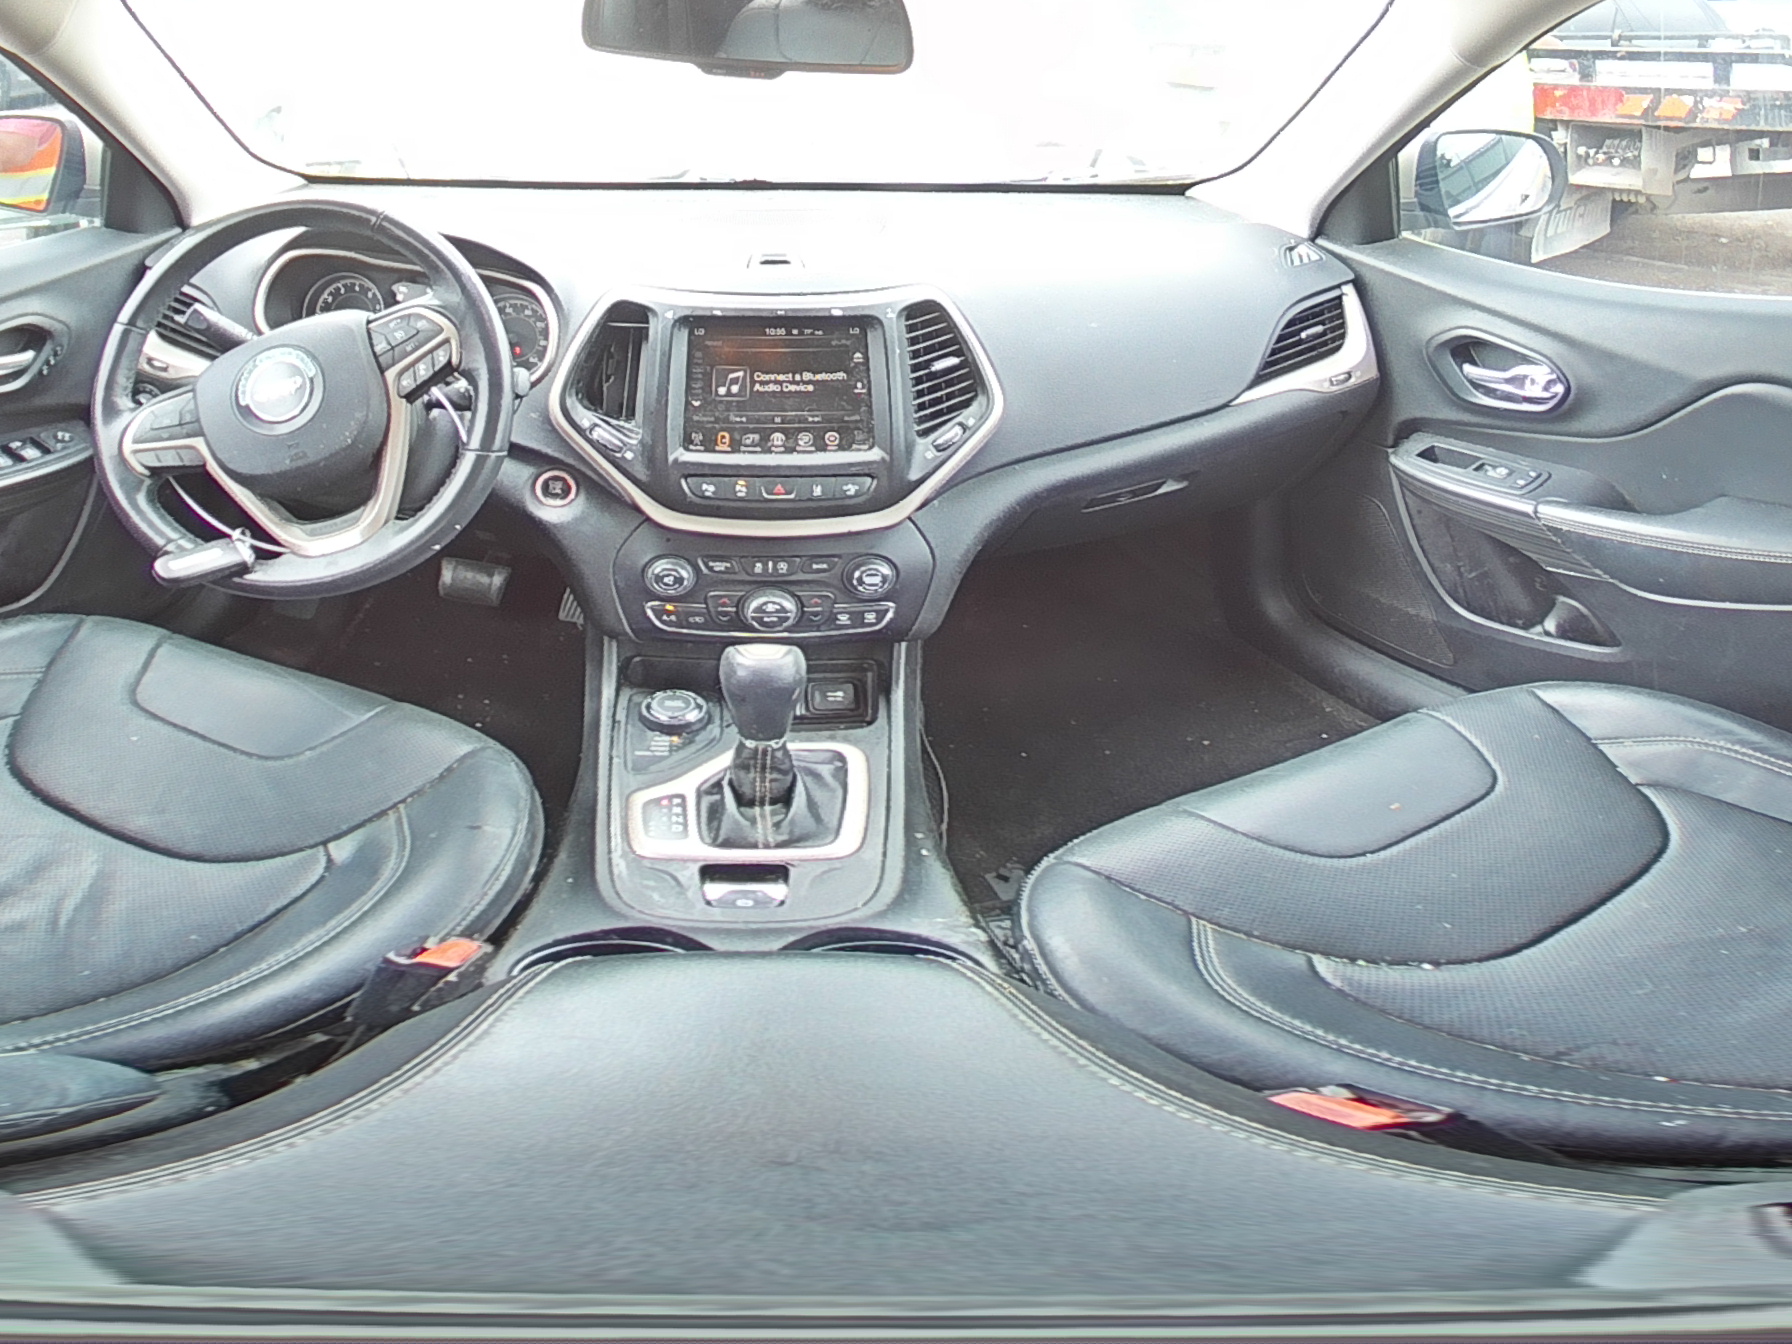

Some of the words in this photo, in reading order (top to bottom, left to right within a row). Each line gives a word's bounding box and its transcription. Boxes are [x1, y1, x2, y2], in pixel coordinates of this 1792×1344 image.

[753, 371, 793, 382] Connect
[794, 373, 801, 381] a
[802, 370, 848, 381] Bluetooth
[753, 383, 781, 393] Audio
[782, 383, 815, 393] Device
